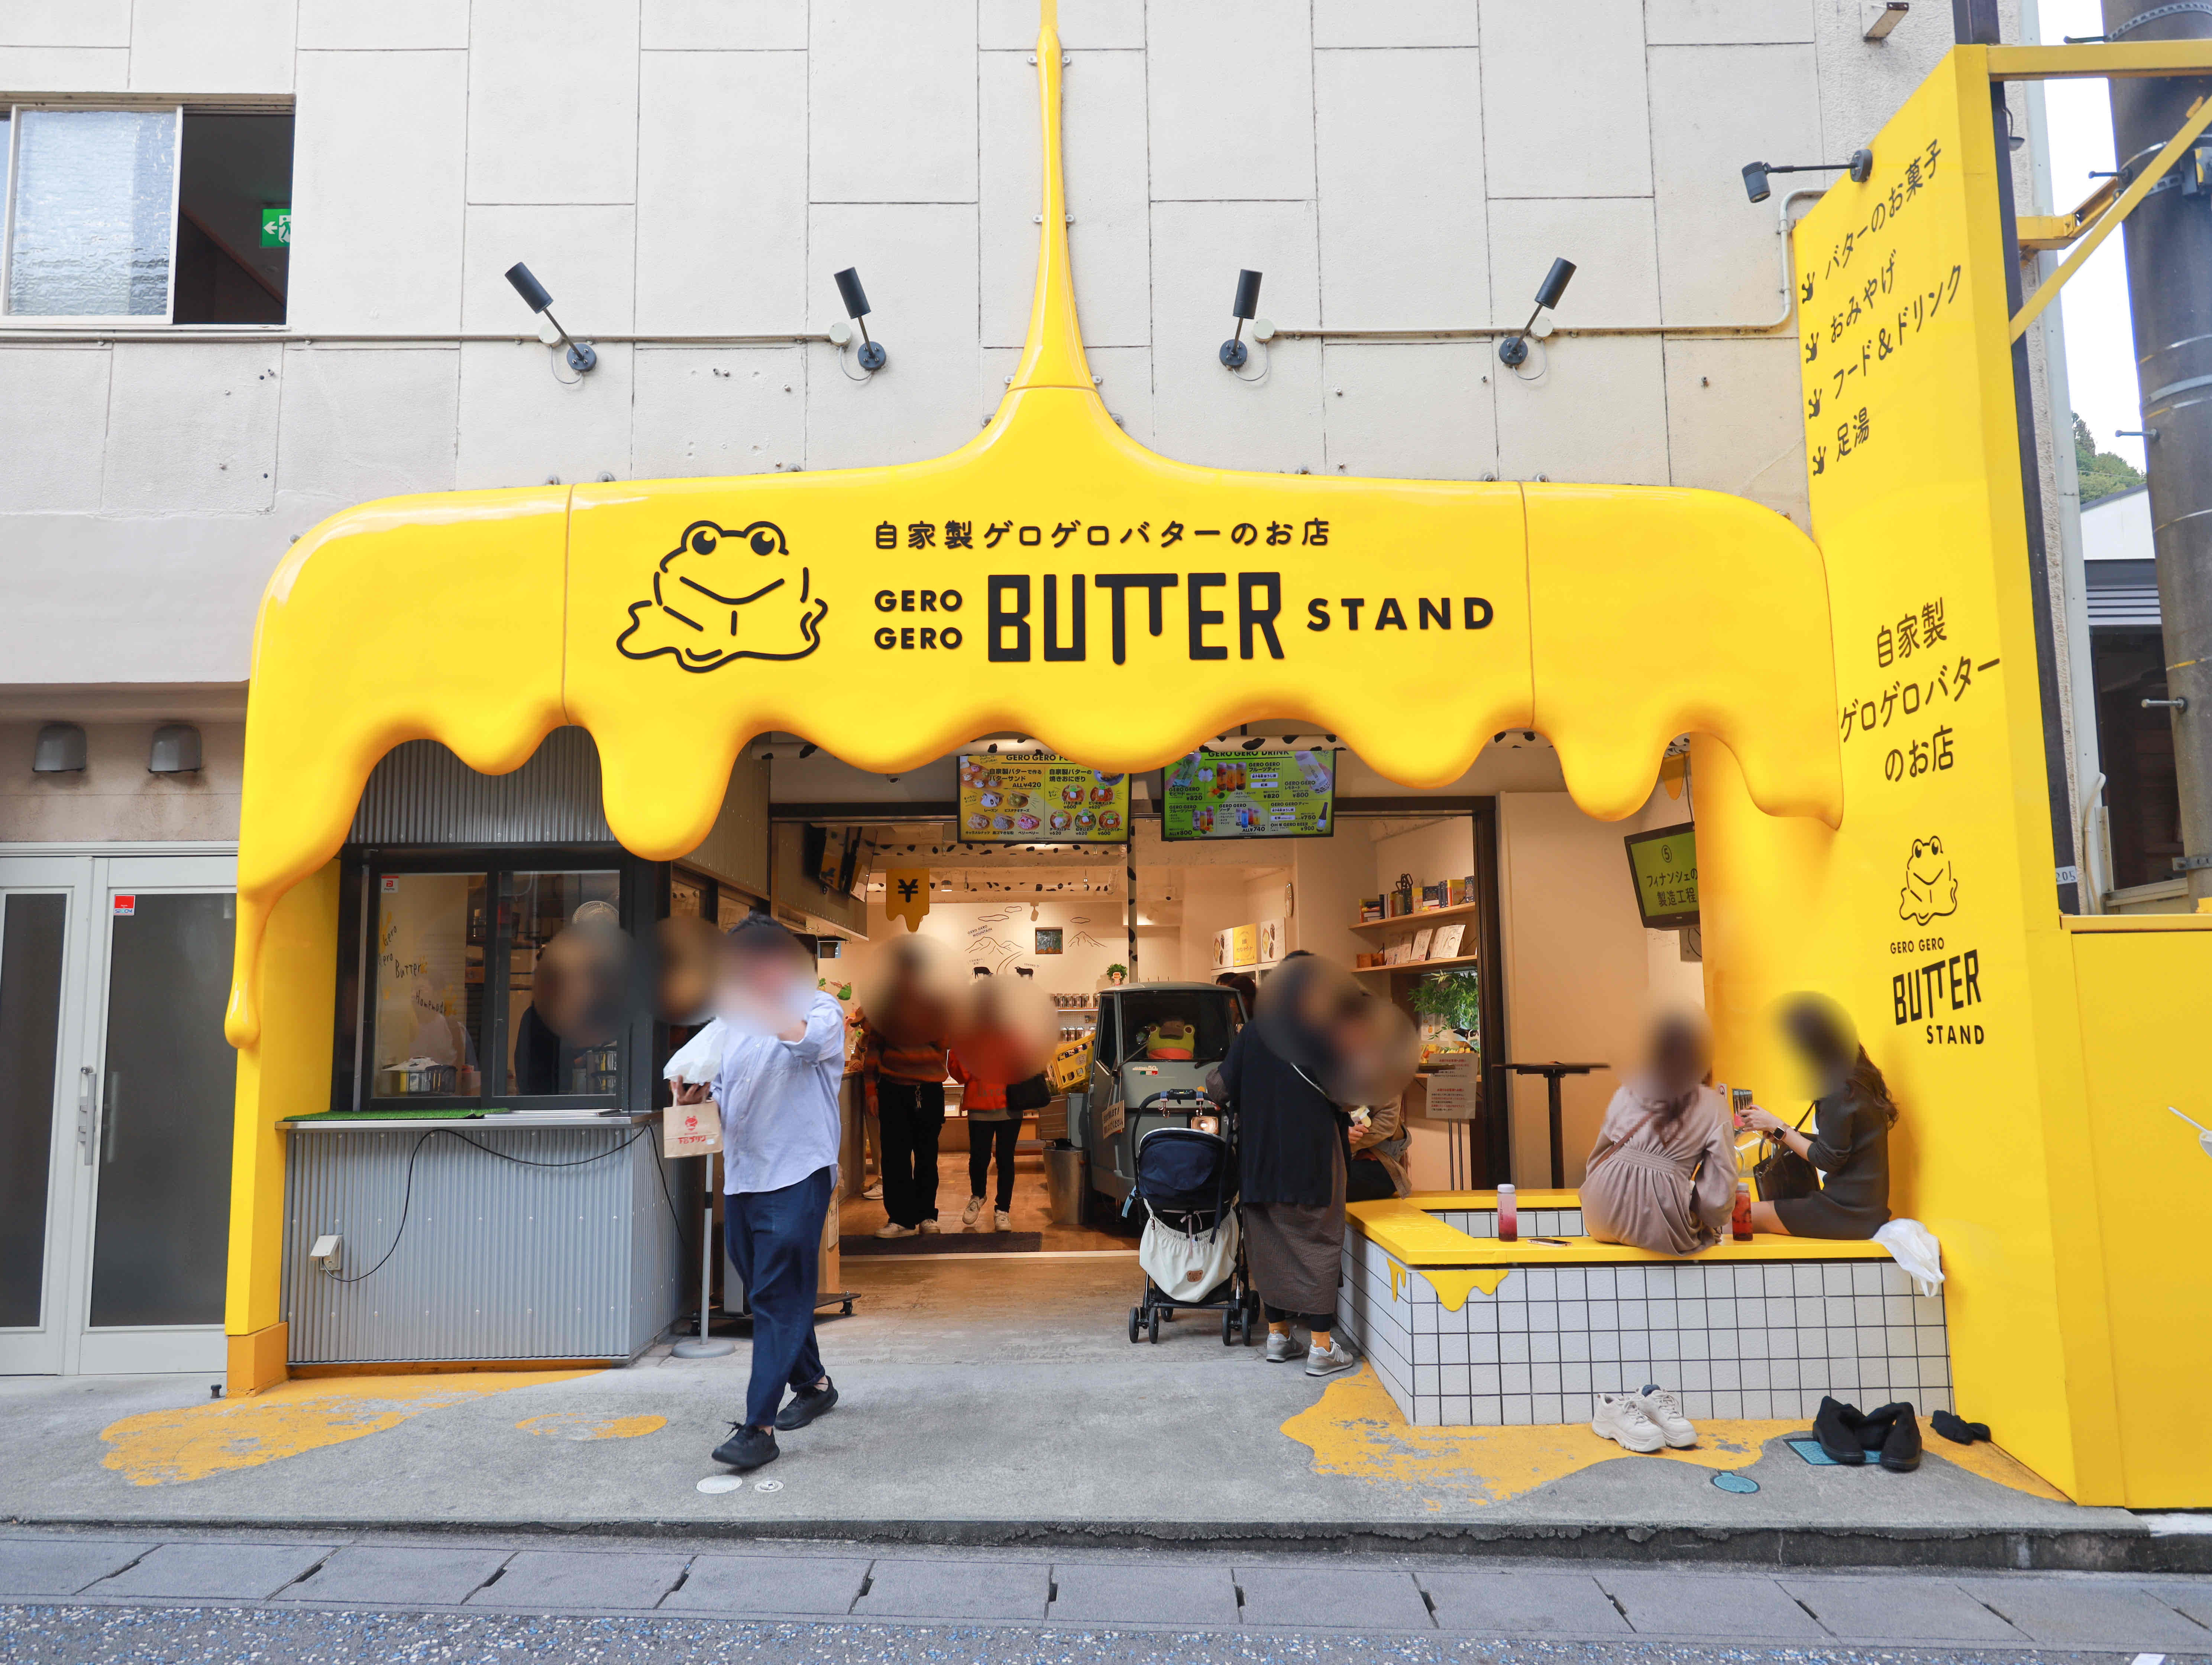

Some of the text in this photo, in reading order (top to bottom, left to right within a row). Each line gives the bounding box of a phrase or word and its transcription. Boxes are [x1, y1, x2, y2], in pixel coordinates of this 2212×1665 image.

[1826, 139, 1941, 279] バターのお菓子
[1831, 249, 1896, 343] おみやげ
[1834, 265, 1961, 399] フード&ドリンク
[1837, 407, 1869, 462] 足湯
[875, 517, 1329, 550] 自家製ゲロゲロバターのお店
[875, 590, 963, 612] GERO
[988, 572, 1493, 665] BUTTER STAND
[874, 627, 963, 649] GERO
[1877, 597, 1947, 667] 自家製
[1841, 656, 2000, 743] ゲロゲロバター
[1885, 725, 1953, 782] のお店
[1647, 868, 1698, 888] フィナンシェの
[1658, 888, 1697, 907] 製造工程
[1890, 937, 1944, 954] GERO GERO
[1893, 949, 1982, 1026] BUTTER
[1927, 1025, 1984, 1044] STAND
